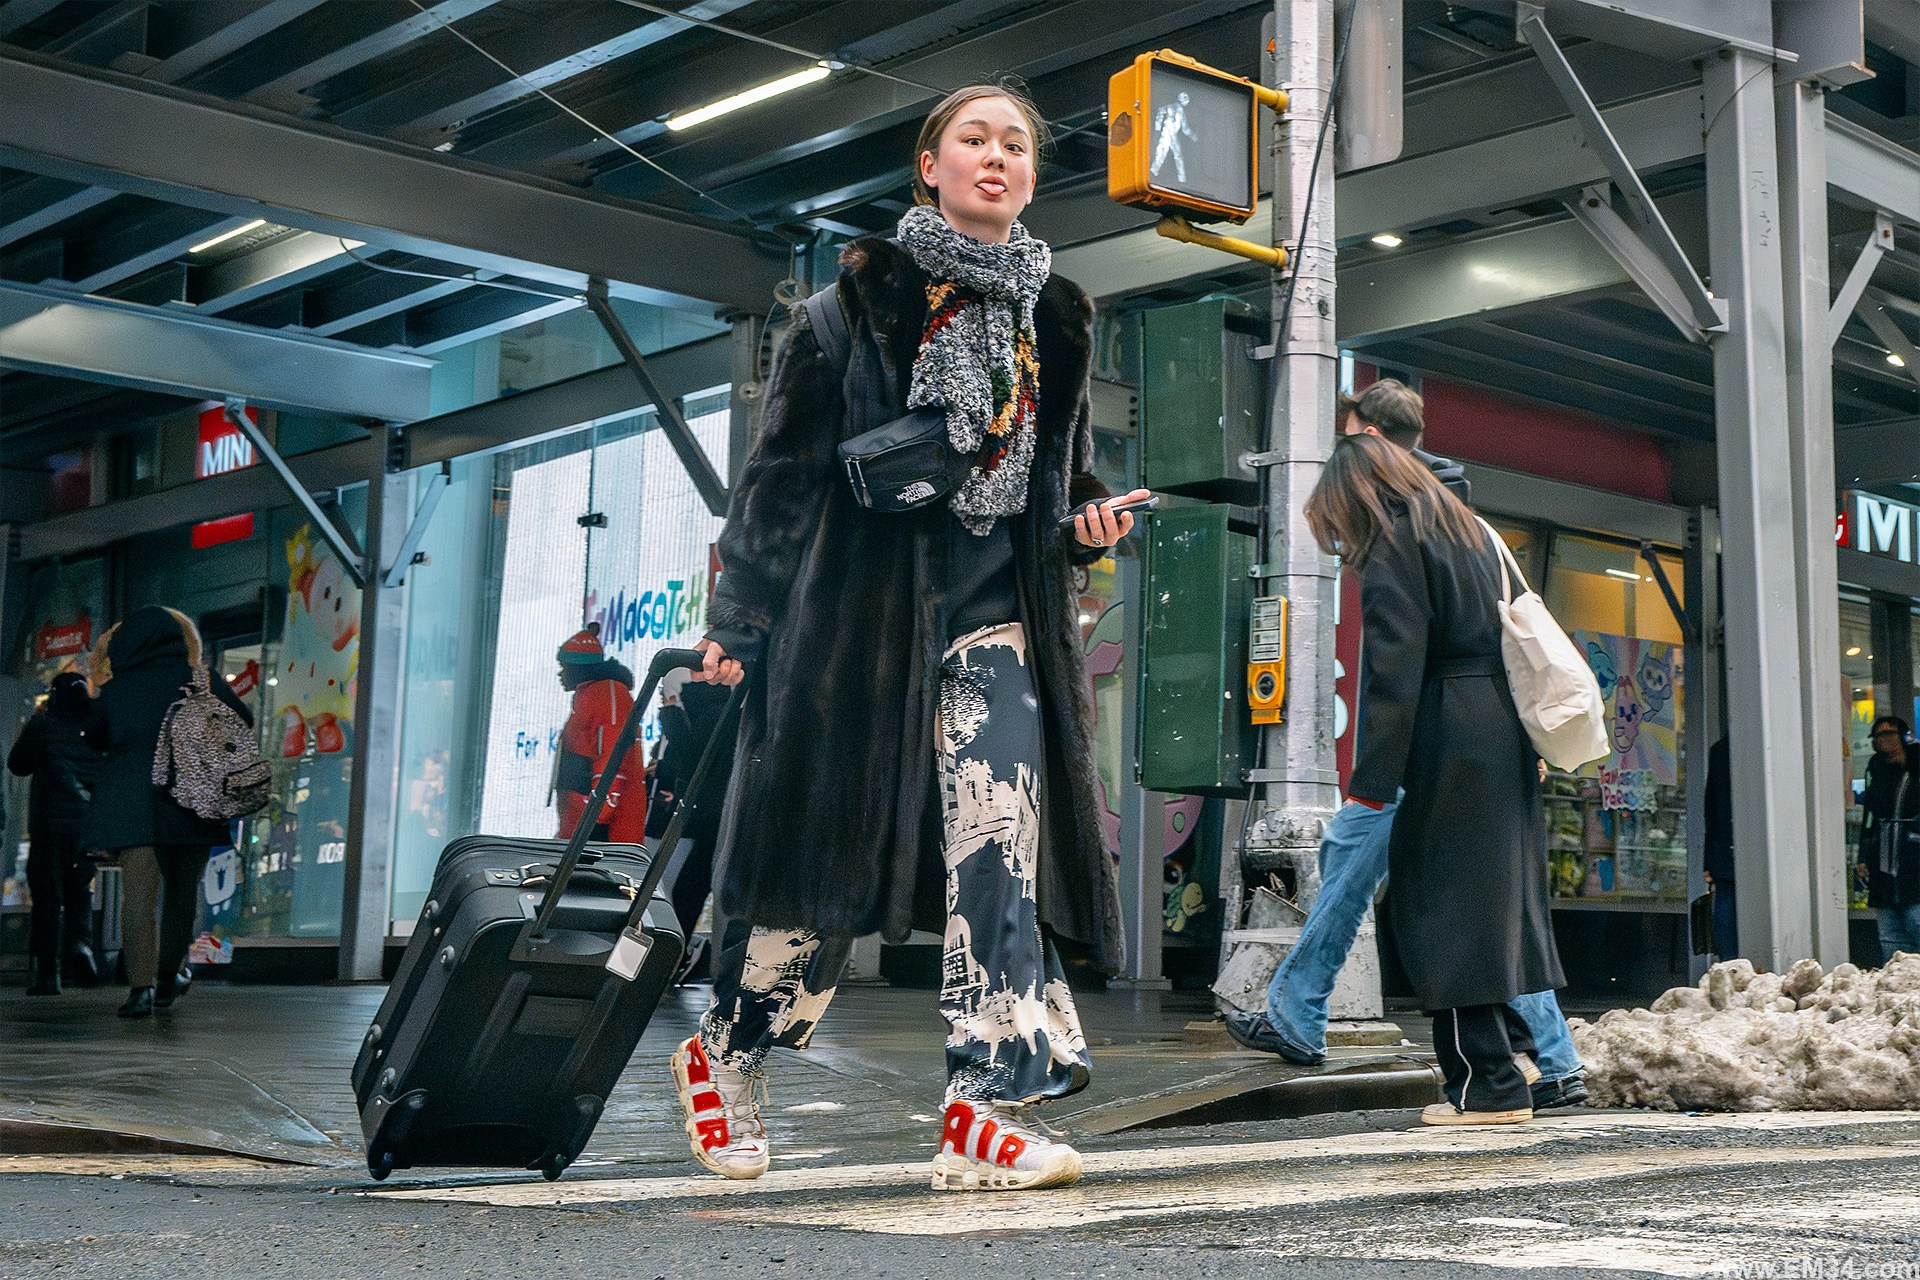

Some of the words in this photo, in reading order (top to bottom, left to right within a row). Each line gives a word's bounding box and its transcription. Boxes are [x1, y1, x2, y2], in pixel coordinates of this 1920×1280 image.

[202, 432, 252, 477] MINI
[896, 488, 921, 500] NORTH
[905, 492, 926, 503] FACE
[1857, 495, 1920, 567] M
[516, 731, 539, 759] For
[685, 1033, 731, 1153] AIR
[940, 1100, 1026, 1168] AIR
